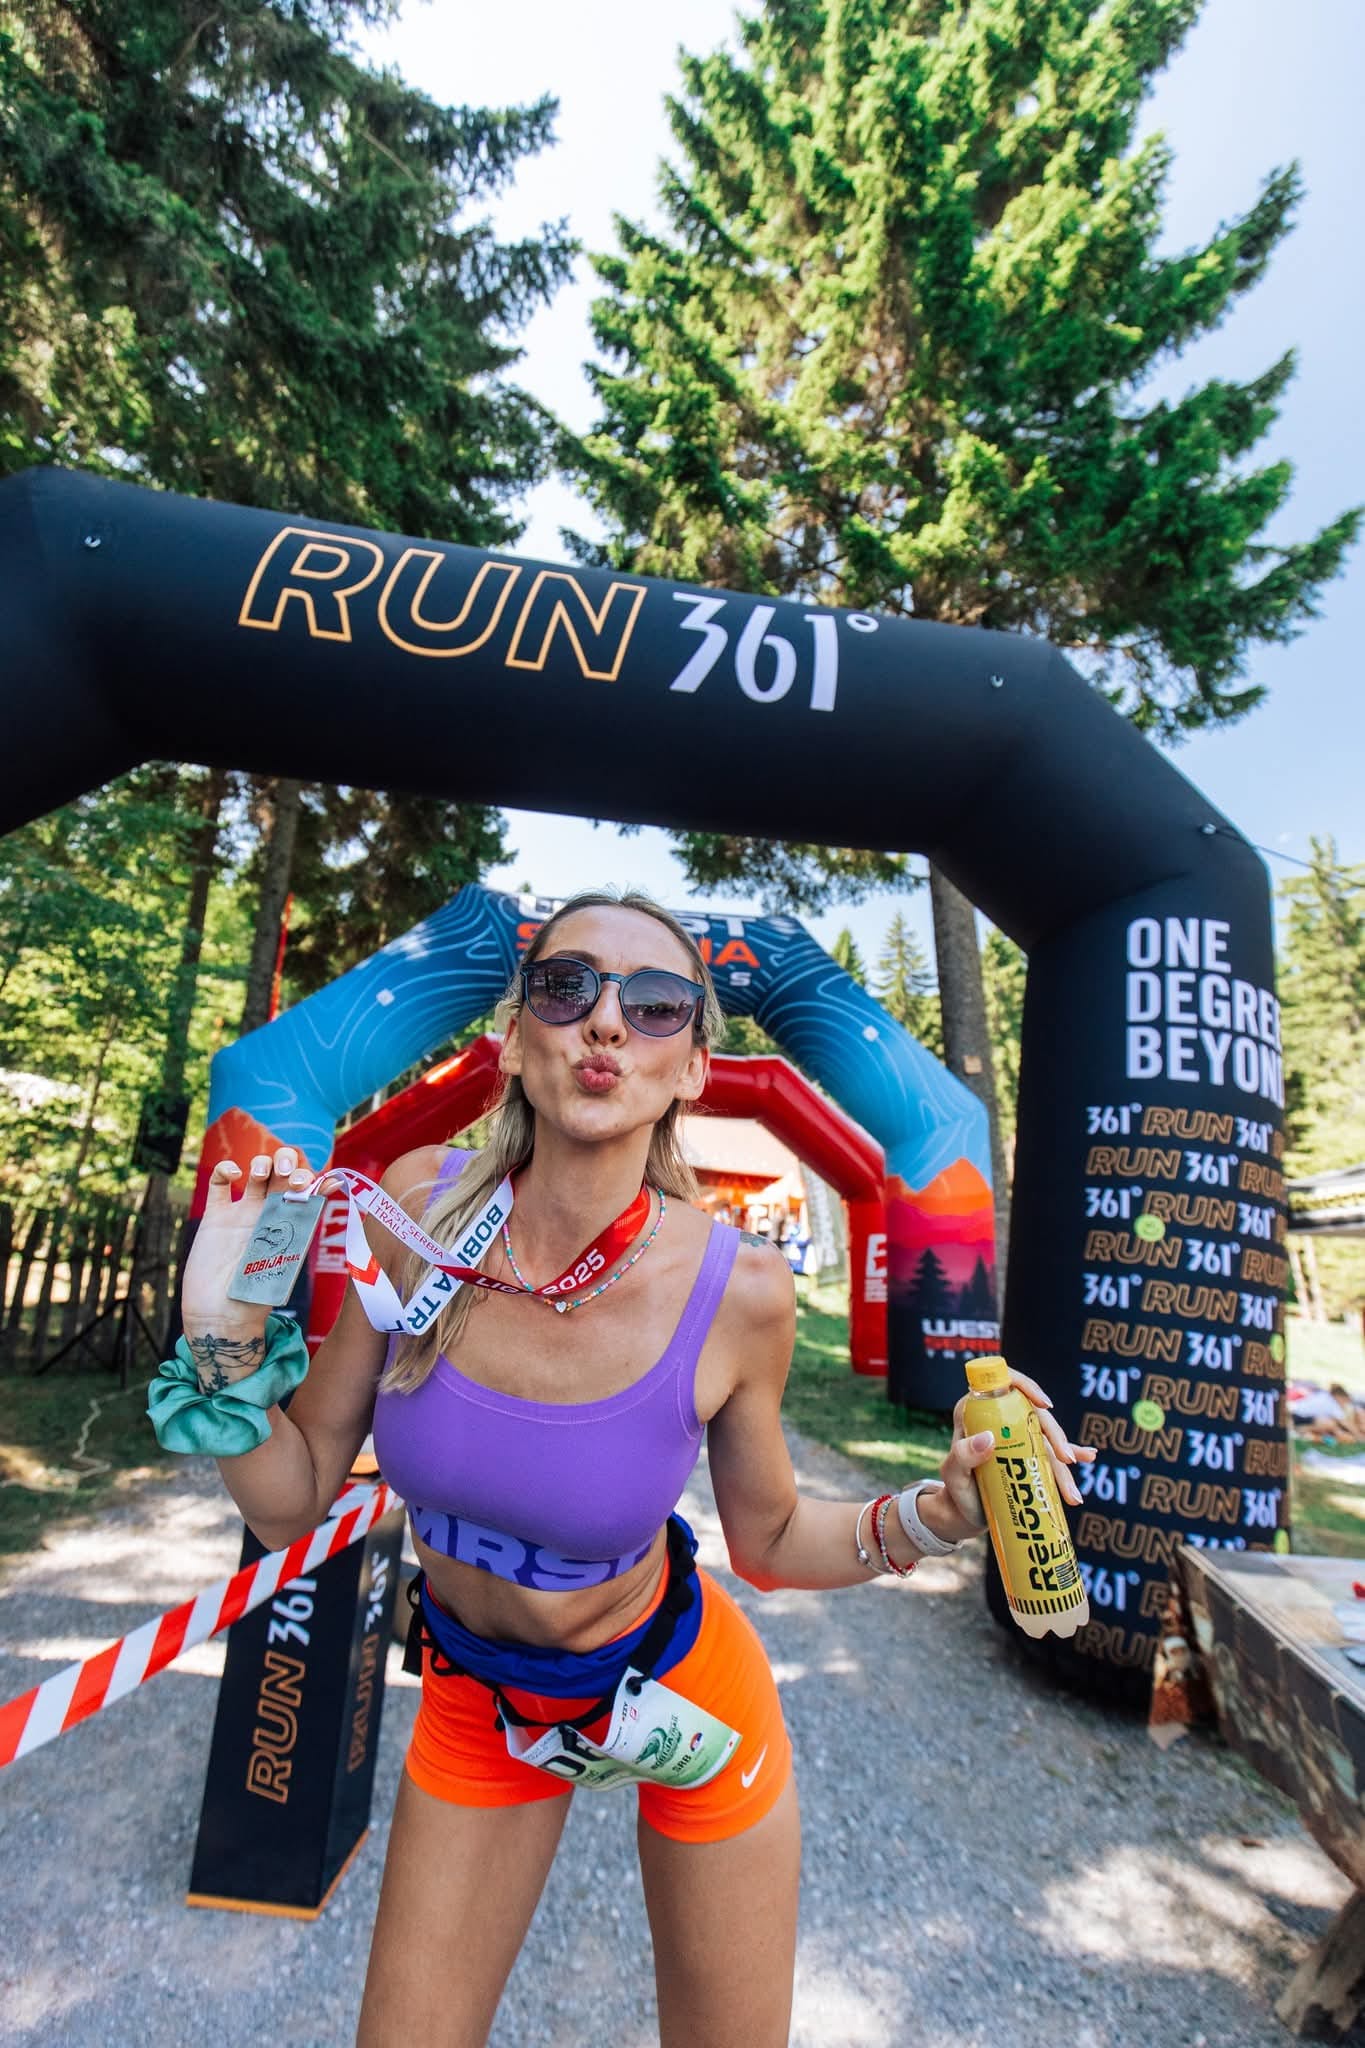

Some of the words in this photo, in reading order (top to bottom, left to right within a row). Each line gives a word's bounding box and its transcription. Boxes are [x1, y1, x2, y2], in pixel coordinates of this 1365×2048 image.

[238, 526, 647, 682] RUN
[668, 592, 879, 712] 361°
[1126, 917, 1232, 974] ONE
[1141, 1106, 1233, 1144] RUN
[1085, 1146, 1182, 1180] RUN
[374, 1206, 408, 1240] TRAILS
[380, 1197, 407, 1226] WEST
[408, 1225, 444, 1260] SERBIA
[1143, 1190, 1236, 1232] RUN
[243, 1254, 284, 1275] BOBIJA
[541, 1248, 605, 1295] 2025
[1084, 1230, 1183, 1269] RUN
[1141, 1279, 1238, 1324] RUN
[1081, 1318, 1183, 1362] RUN
[1141, 1374, 1239, 1421] RUN
[1079, 1412, 1183, 1463] RUN
[1027, 1456, 1050, 1512] LONG
[1140, 1474, 1241, 1526] RUN
[996, 1456, 1058, 1591] Reload
[246, 1651, 306, 1804] RUN
